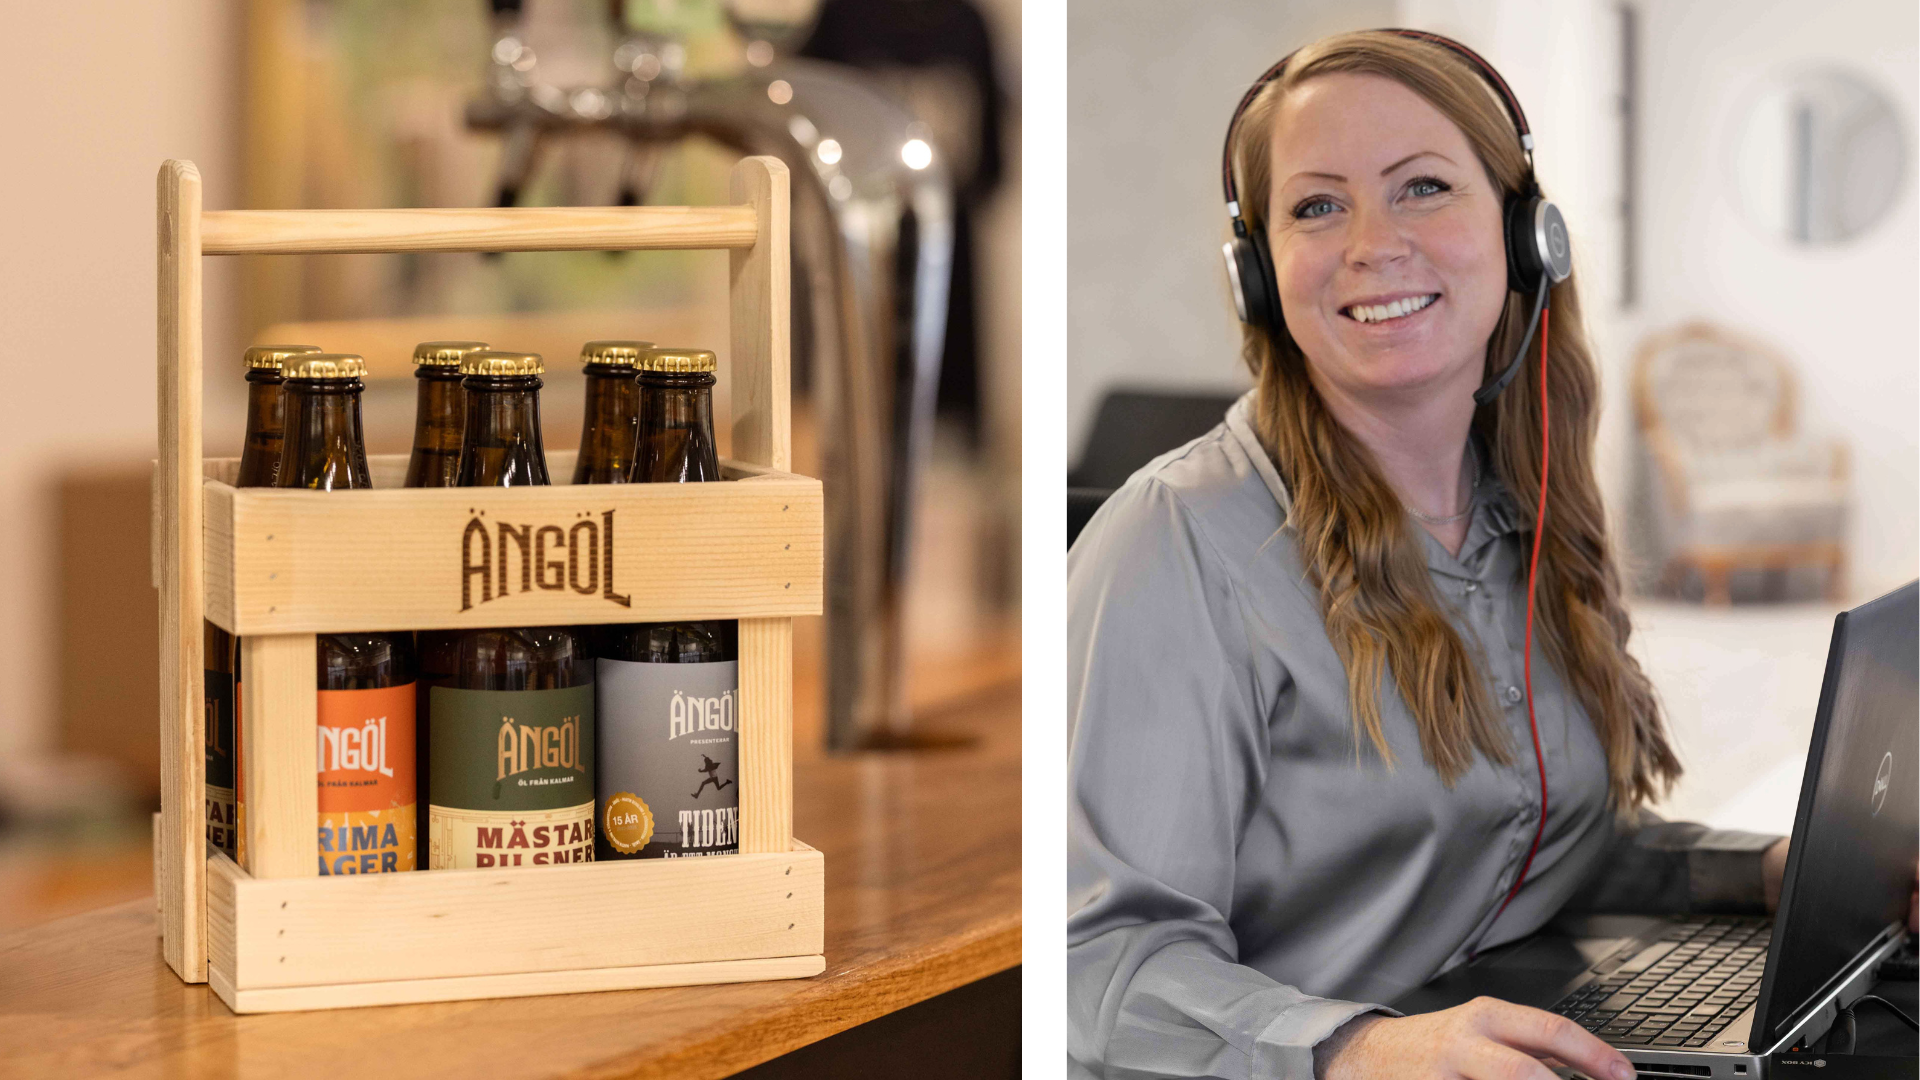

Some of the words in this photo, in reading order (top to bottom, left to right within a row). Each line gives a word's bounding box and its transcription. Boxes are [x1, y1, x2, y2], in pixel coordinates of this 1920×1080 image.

[460, 507, 631, 613] ÄNGÖL
[668, 689, 739, 741] ÄNGÖL
[317, 716, 394, 778] NGÖL
[496, 714, 585, 781] ÄNGÖL
[690, 737, 730, 745] PRESENTERAR
[518, 778, 528, 787] ÖL
[529, 777, 549, 787] FRÅN
[550, 776, 574, 785] KALMAR
[476, 818, 593, 849] MÄSTAR
[612, 815, 623, 826] 15
[624, 812, 639, 825] ÅR
[678, 806, 738, 848] TIDEN
[318, 823, 399, 852] RIMA
[318, 851, 399, 876] AGER
